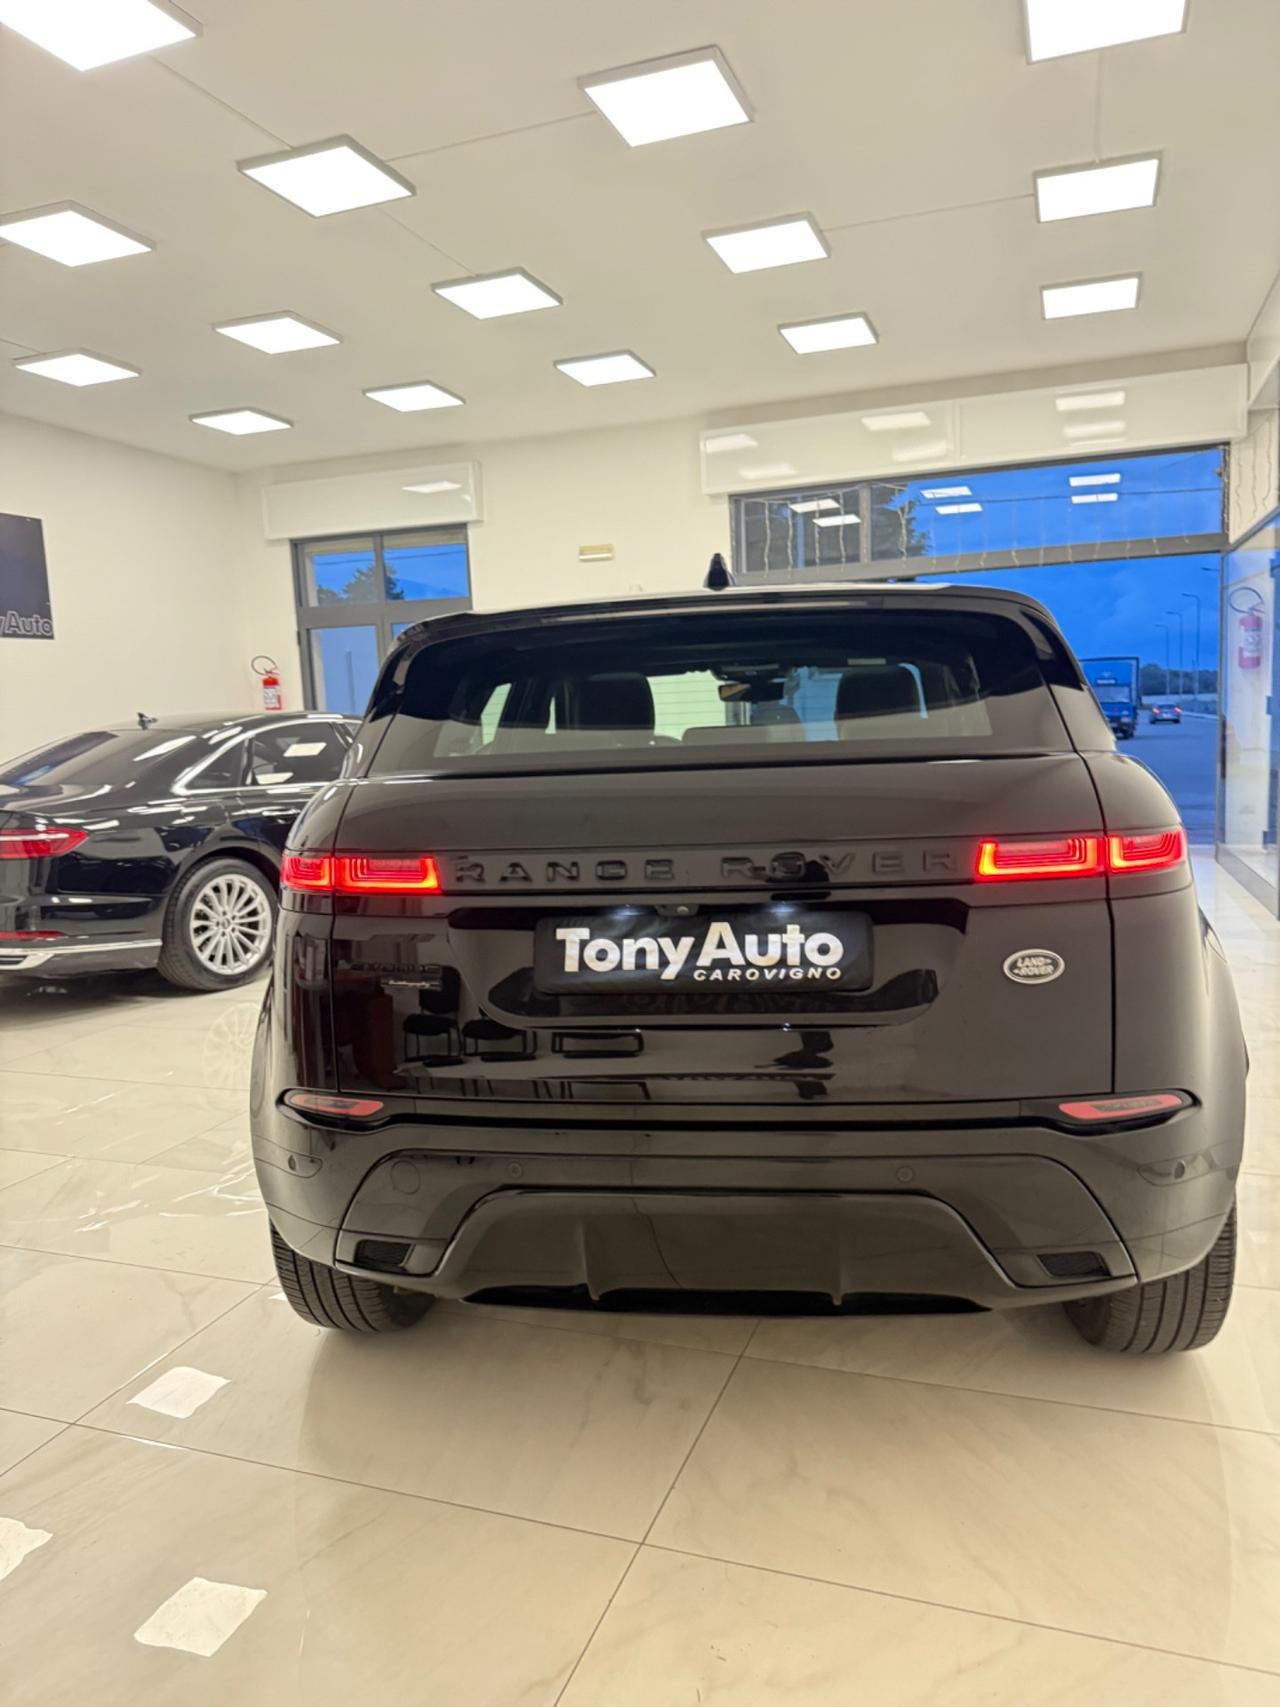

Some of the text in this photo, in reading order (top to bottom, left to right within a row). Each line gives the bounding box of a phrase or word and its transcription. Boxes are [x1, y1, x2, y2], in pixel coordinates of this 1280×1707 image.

[456, 850, 955, 882] RANGE ROVER
[693, 967, 842, 982] CAROVIGNO
